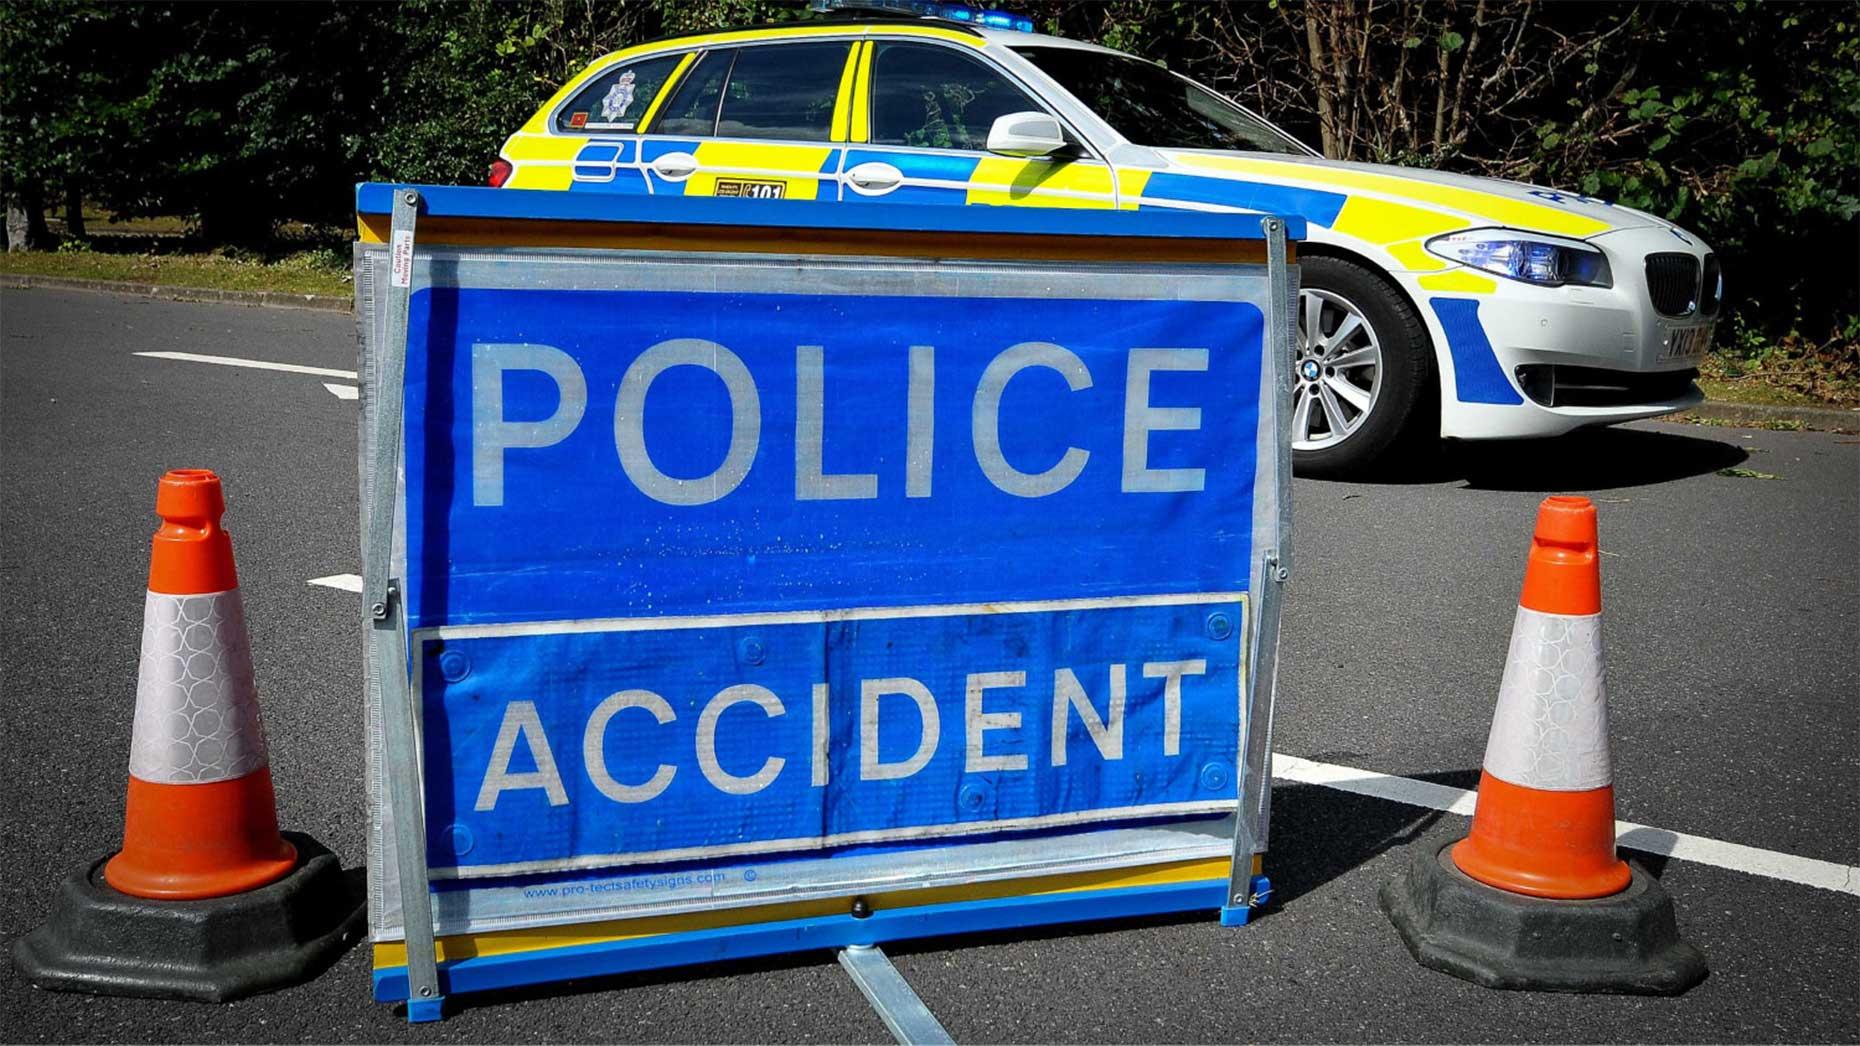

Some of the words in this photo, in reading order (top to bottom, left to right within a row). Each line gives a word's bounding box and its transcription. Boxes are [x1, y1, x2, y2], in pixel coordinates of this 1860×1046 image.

[752, 185, 781, 199] 101
[393, 244, 402, 273] Caution
[402, 236, 411, 255] Parts
[401, 257, 410, 284] Moving
[471, 338, 1210, 507] POLICE
[474, 658, 1207, 812] ACCIDENT
[524, 873, 725, 898] www.pro-tectsafetysigns.com
